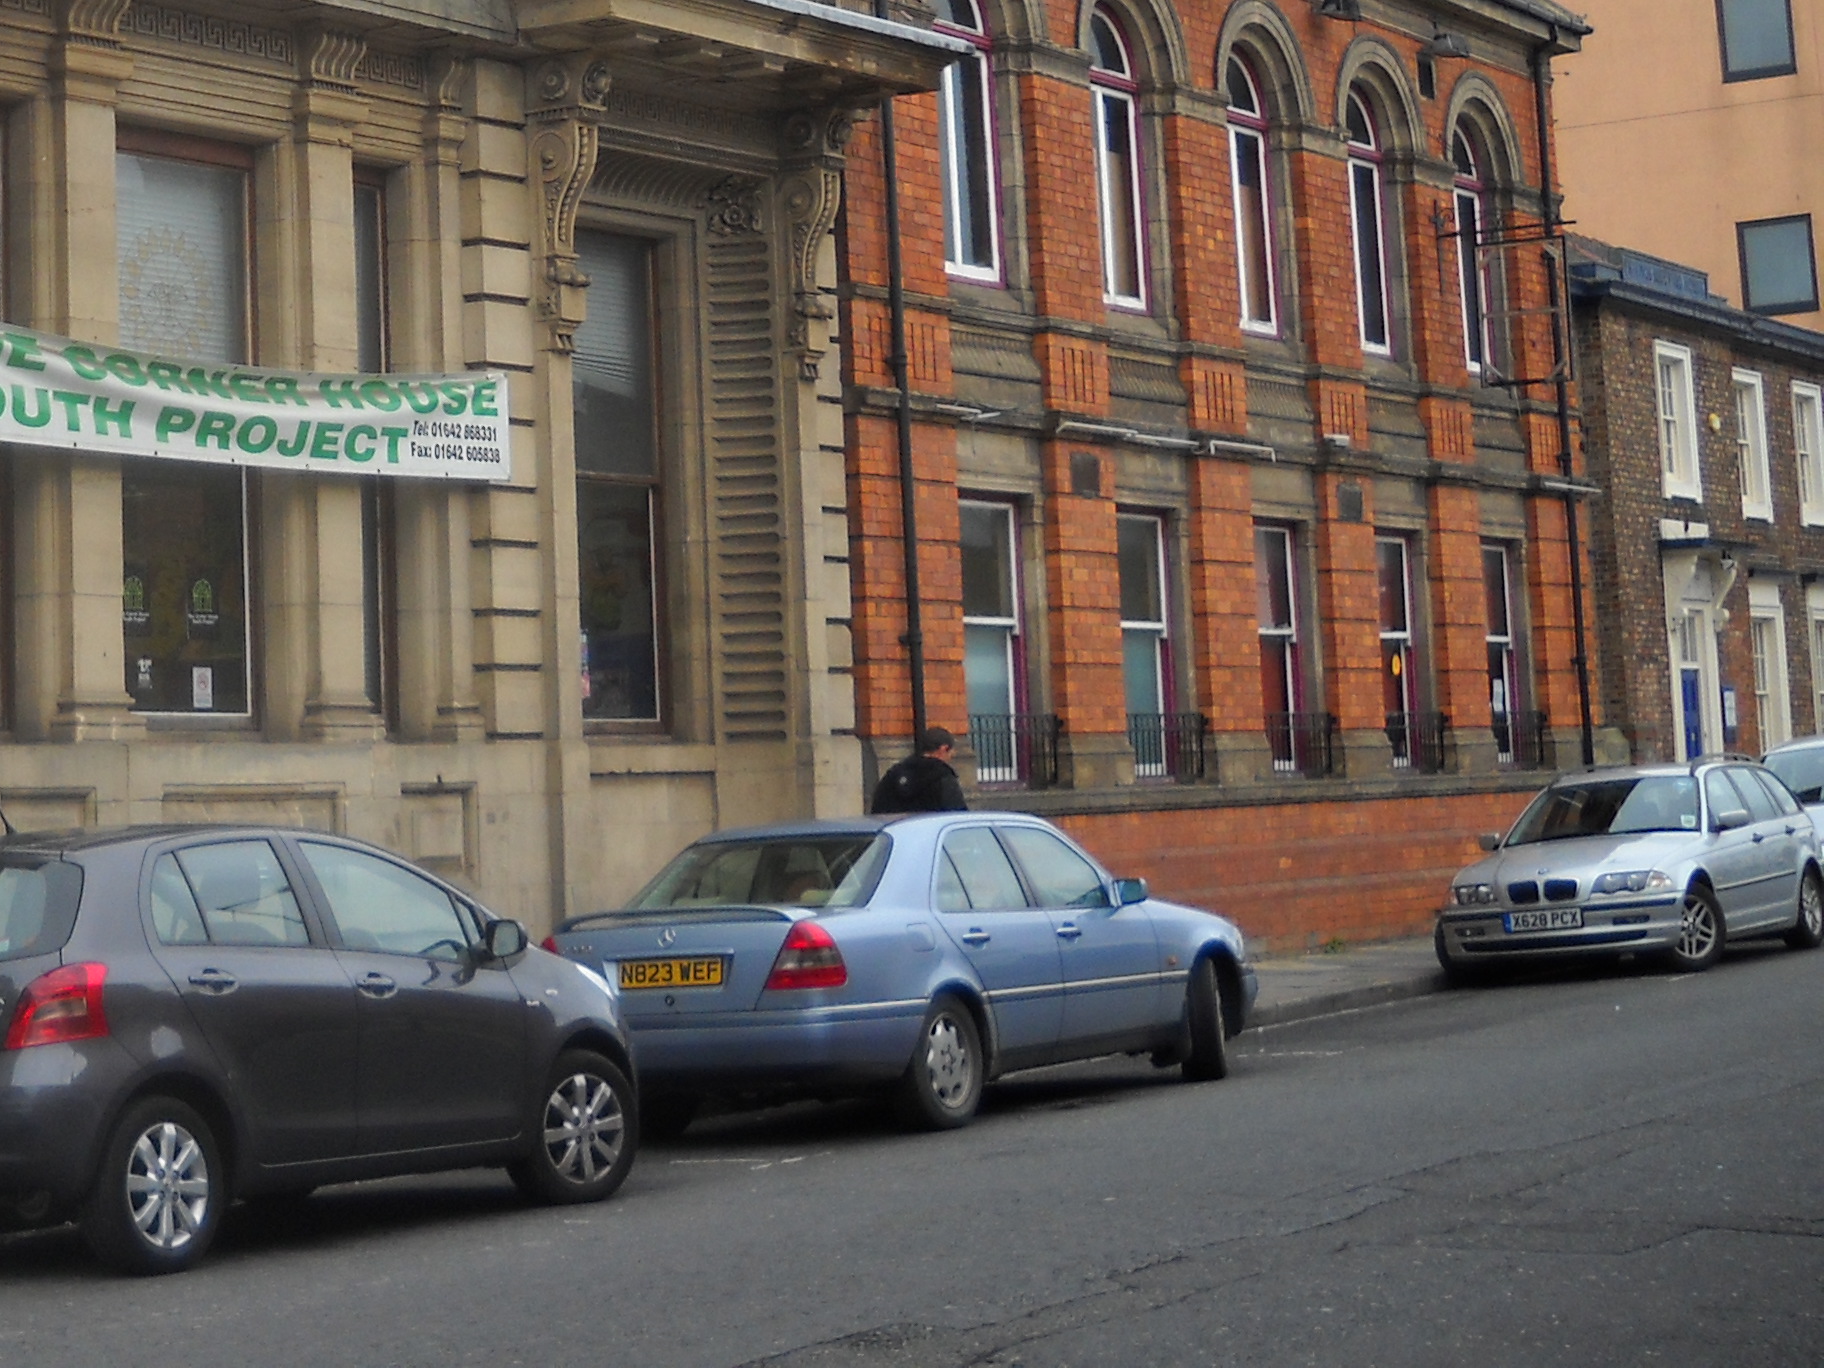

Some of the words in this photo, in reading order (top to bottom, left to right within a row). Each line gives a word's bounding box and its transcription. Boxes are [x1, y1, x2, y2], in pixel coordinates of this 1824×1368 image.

[62, 340, 309, 407] CORNER
[320, 378, 500, 417] HOUSE
[155, 408, 408, 464] PROJECT
[412, 419, 429, 437] Tel:
[430, 421, 463, 439] 01642
[410, 440, 433, 458] Fax:
[433, 443, 464, 460] 01642
[1550, 910, 1579, 925] PCX
[621, 964, 674, 985] N823
[679, 961, 720, 983] WEF
